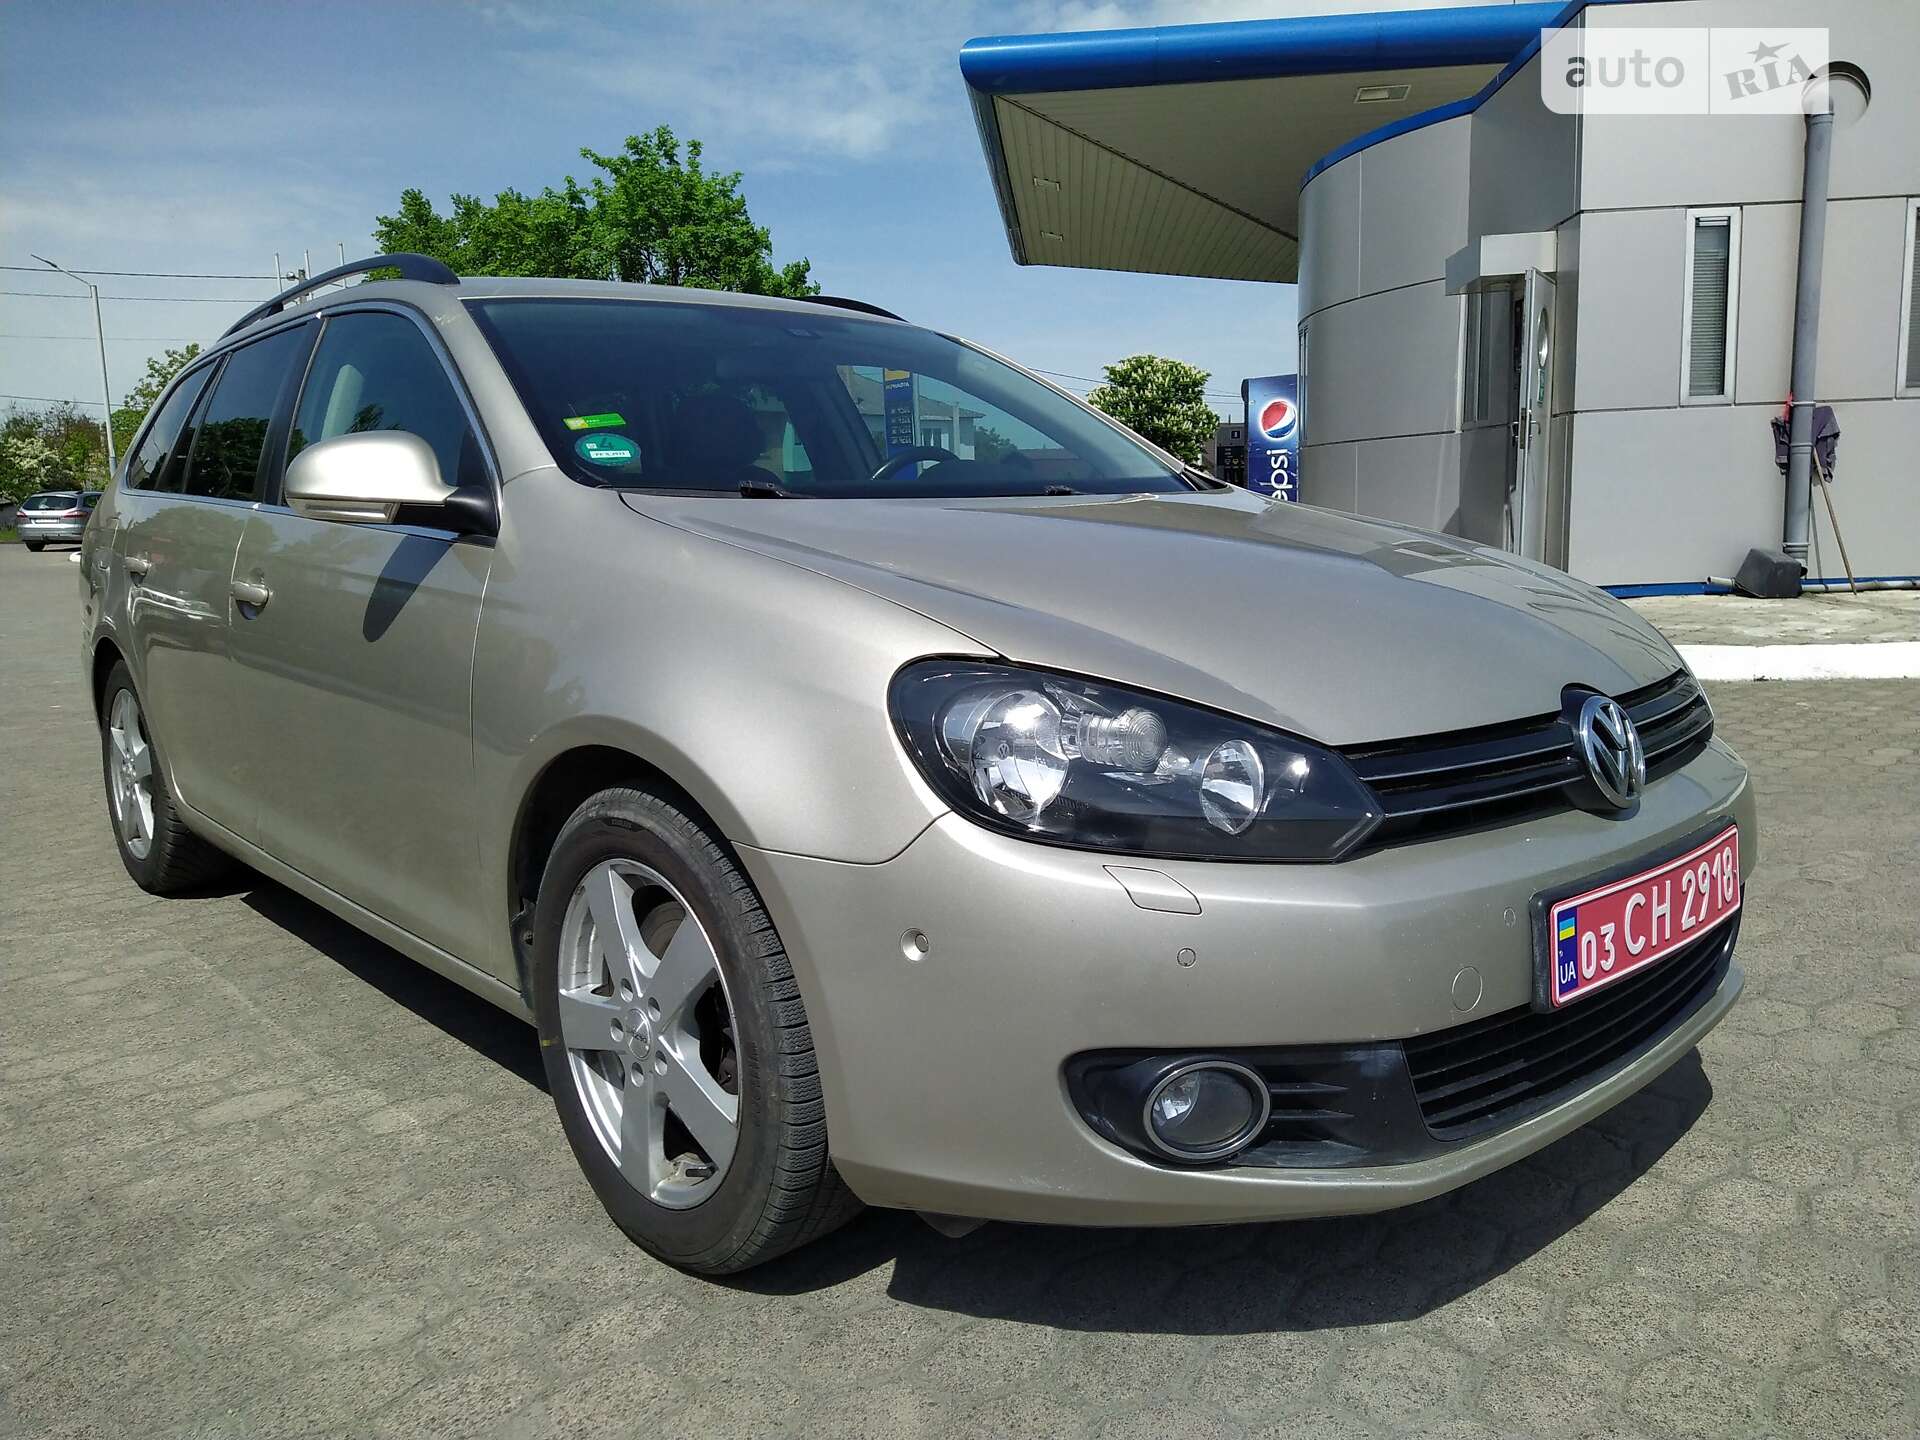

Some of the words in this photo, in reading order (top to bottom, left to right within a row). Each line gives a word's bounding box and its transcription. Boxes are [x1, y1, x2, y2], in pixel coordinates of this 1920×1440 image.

[1266, 449, 1293, 501] epsi
[1581, 922, 1616, 980] 03
[1624, 880, 1672, 956] CH
[1681, 846, 1734, 932] 2918
[1559, 961, 1577, 985] UA
